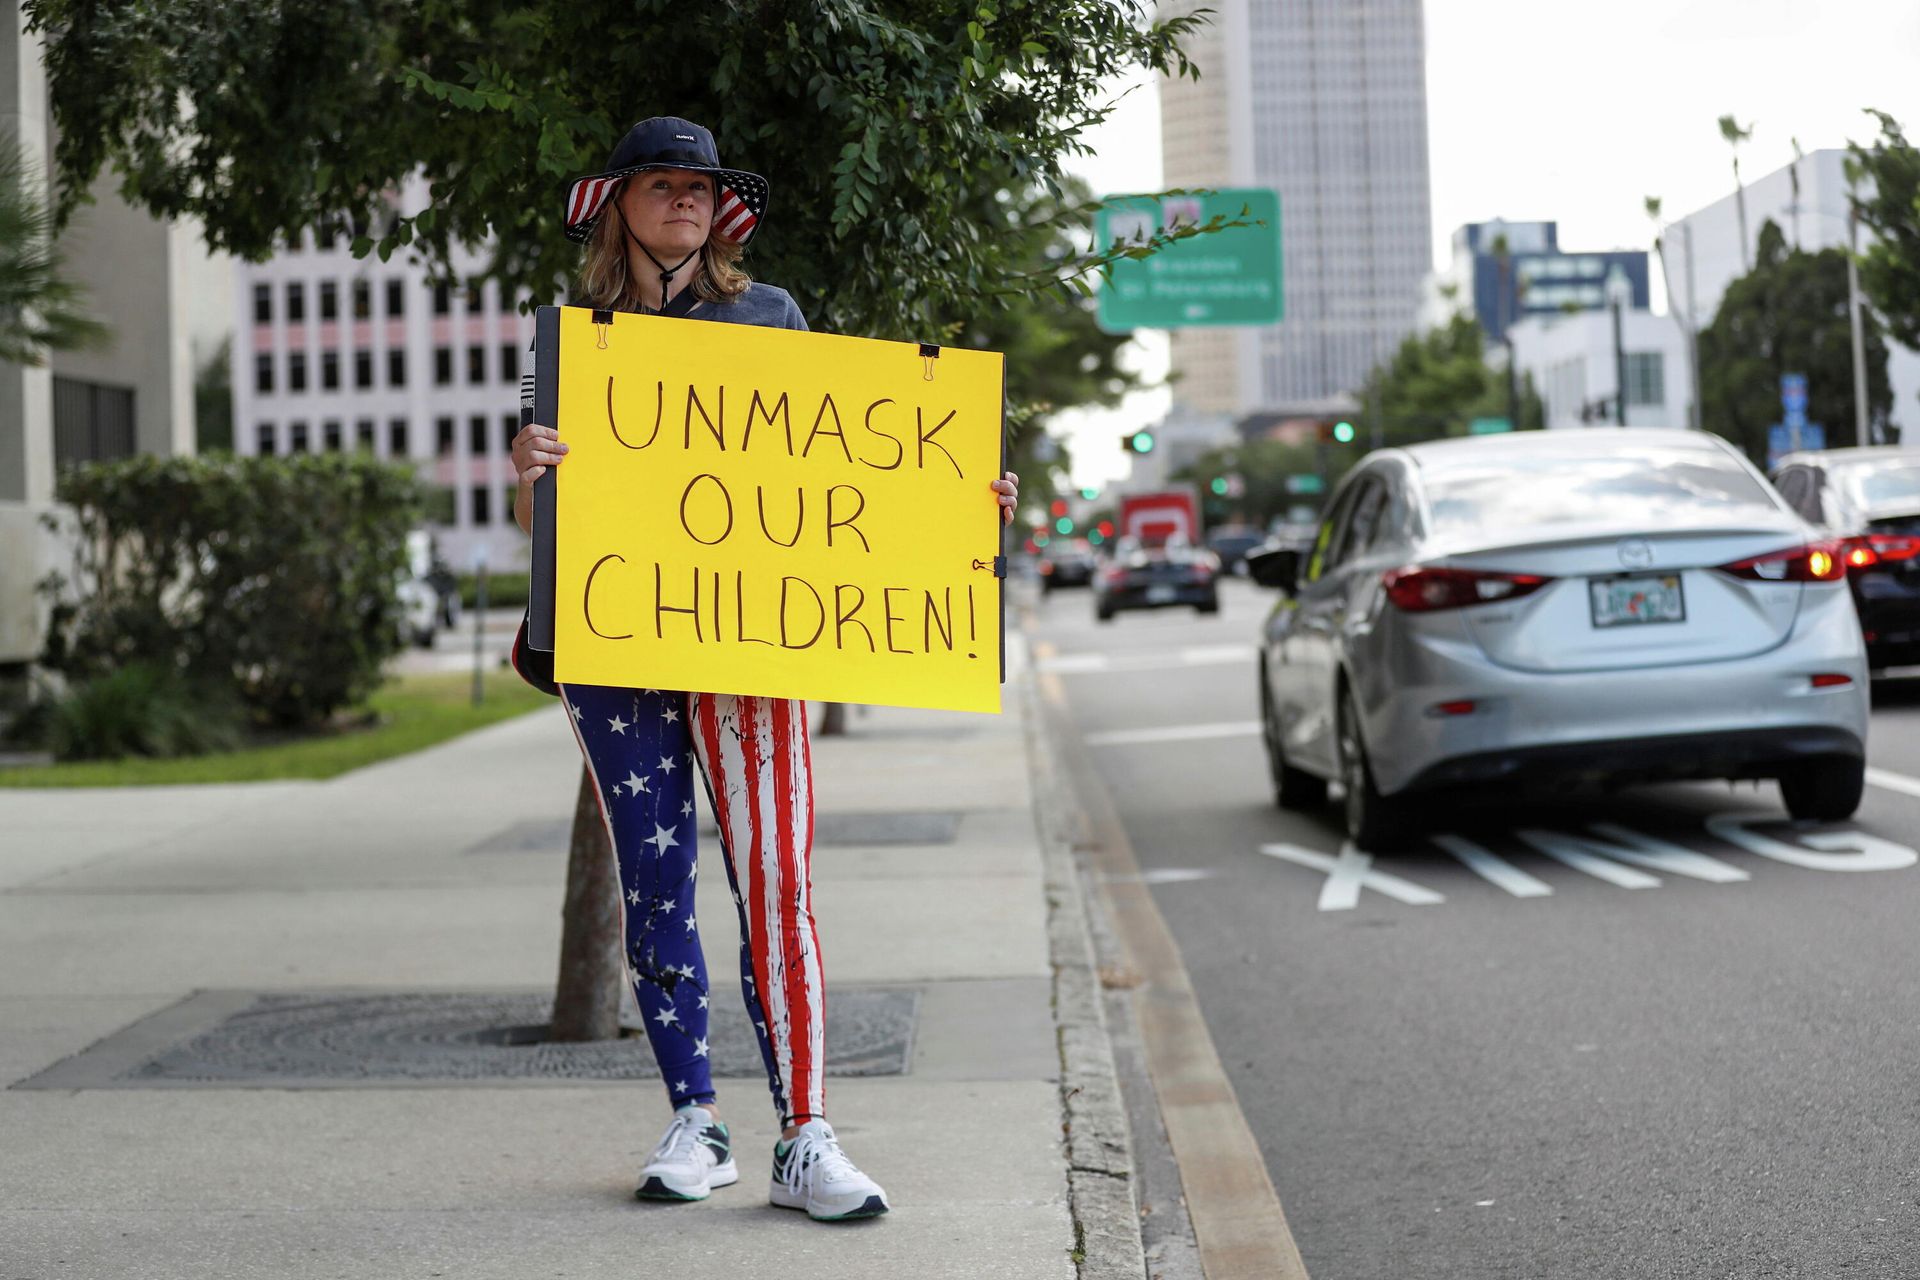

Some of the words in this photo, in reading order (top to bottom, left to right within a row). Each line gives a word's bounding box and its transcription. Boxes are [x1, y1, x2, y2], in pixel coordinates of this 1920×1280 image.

[608, 375, 964, 480] UNMASK
[680, 473, 871, 553] OUR
[584, 554, 979, 660] CHILDREN!
[1259, 813, 1918, 911] XING
